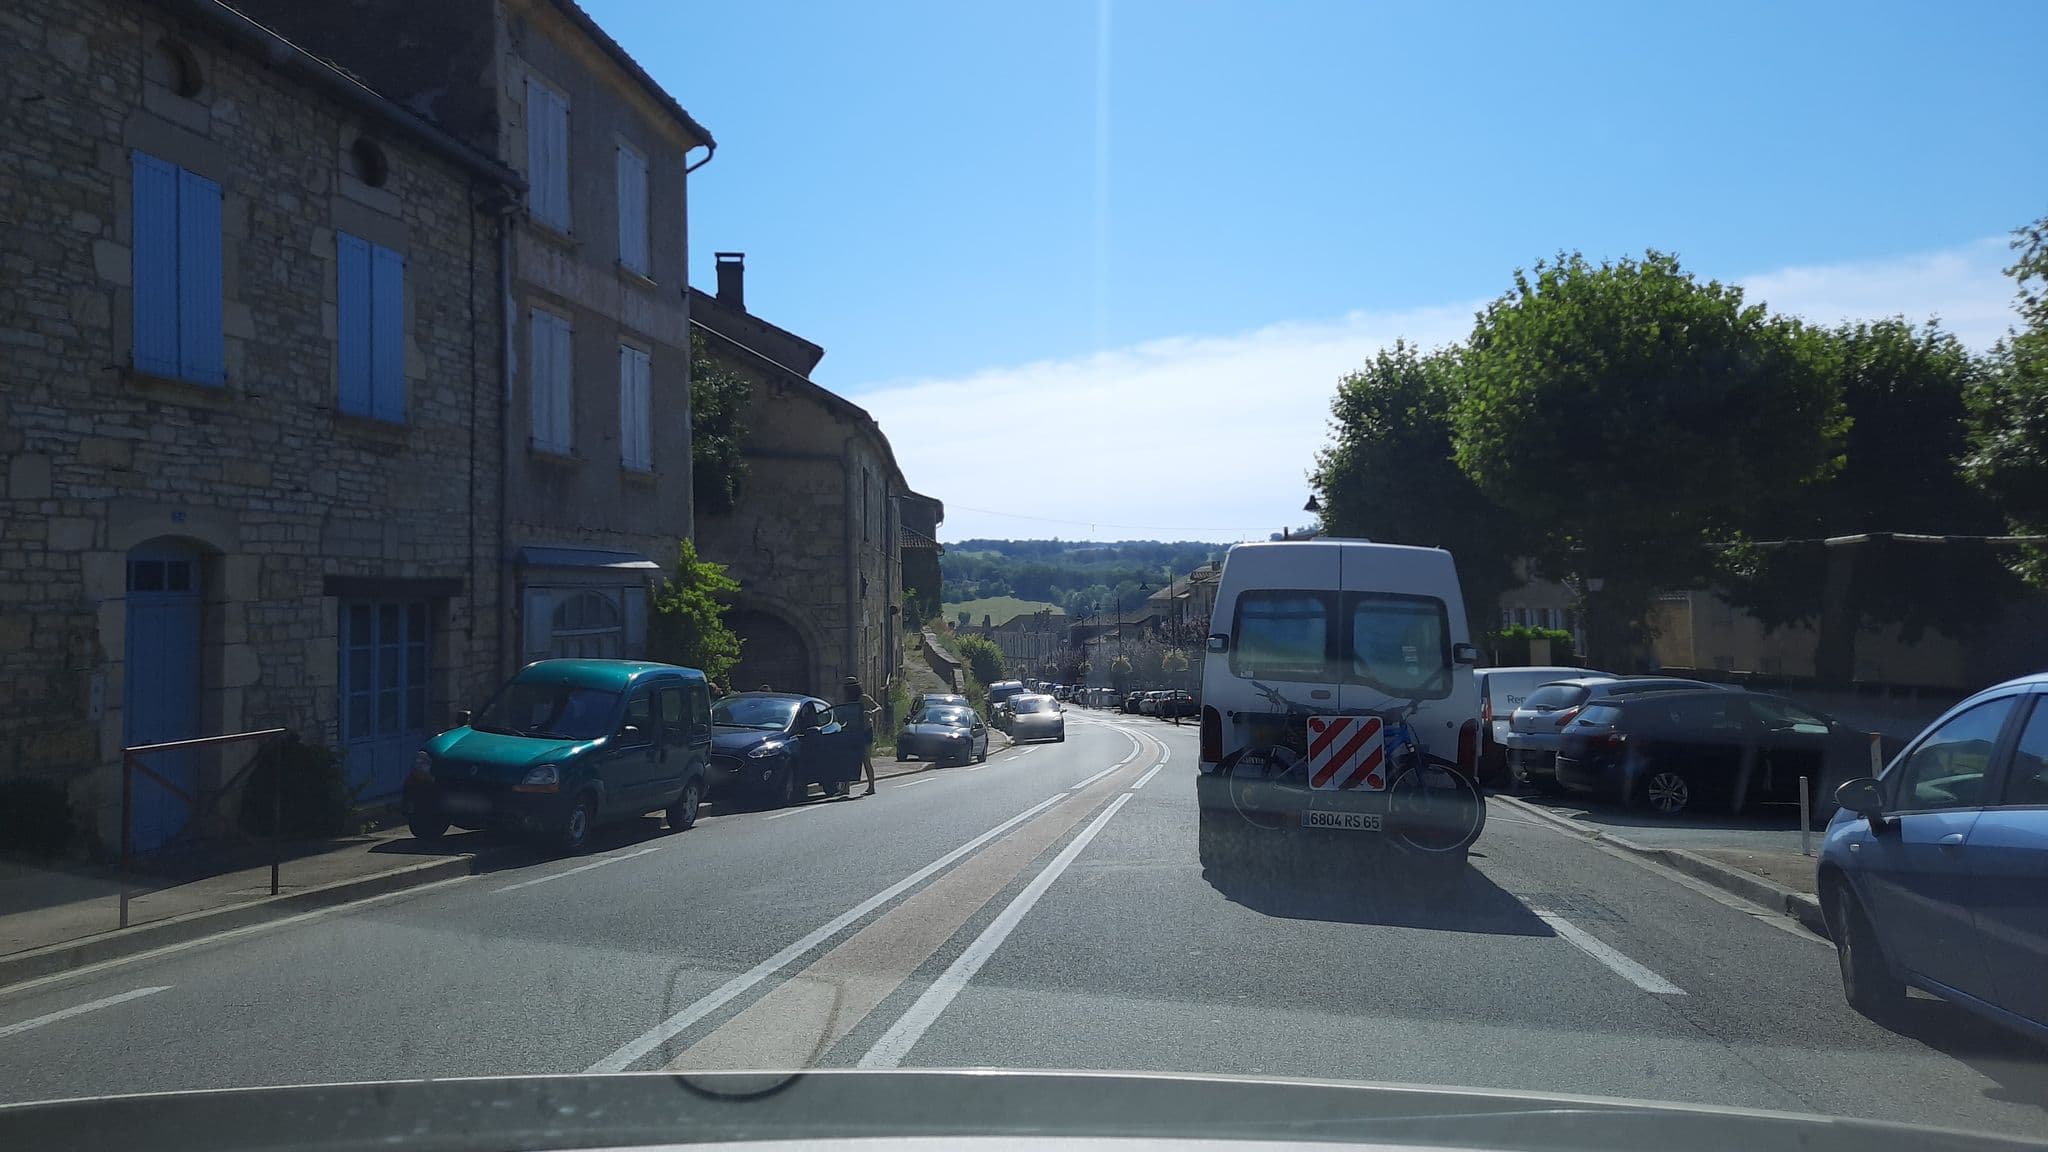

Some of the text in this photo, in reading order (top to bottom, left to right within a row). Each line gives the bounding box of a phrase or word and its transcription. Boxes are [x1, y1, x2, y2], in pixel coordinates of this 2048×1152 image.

[1310, 812, 1380, 829] 6804 RS 65
